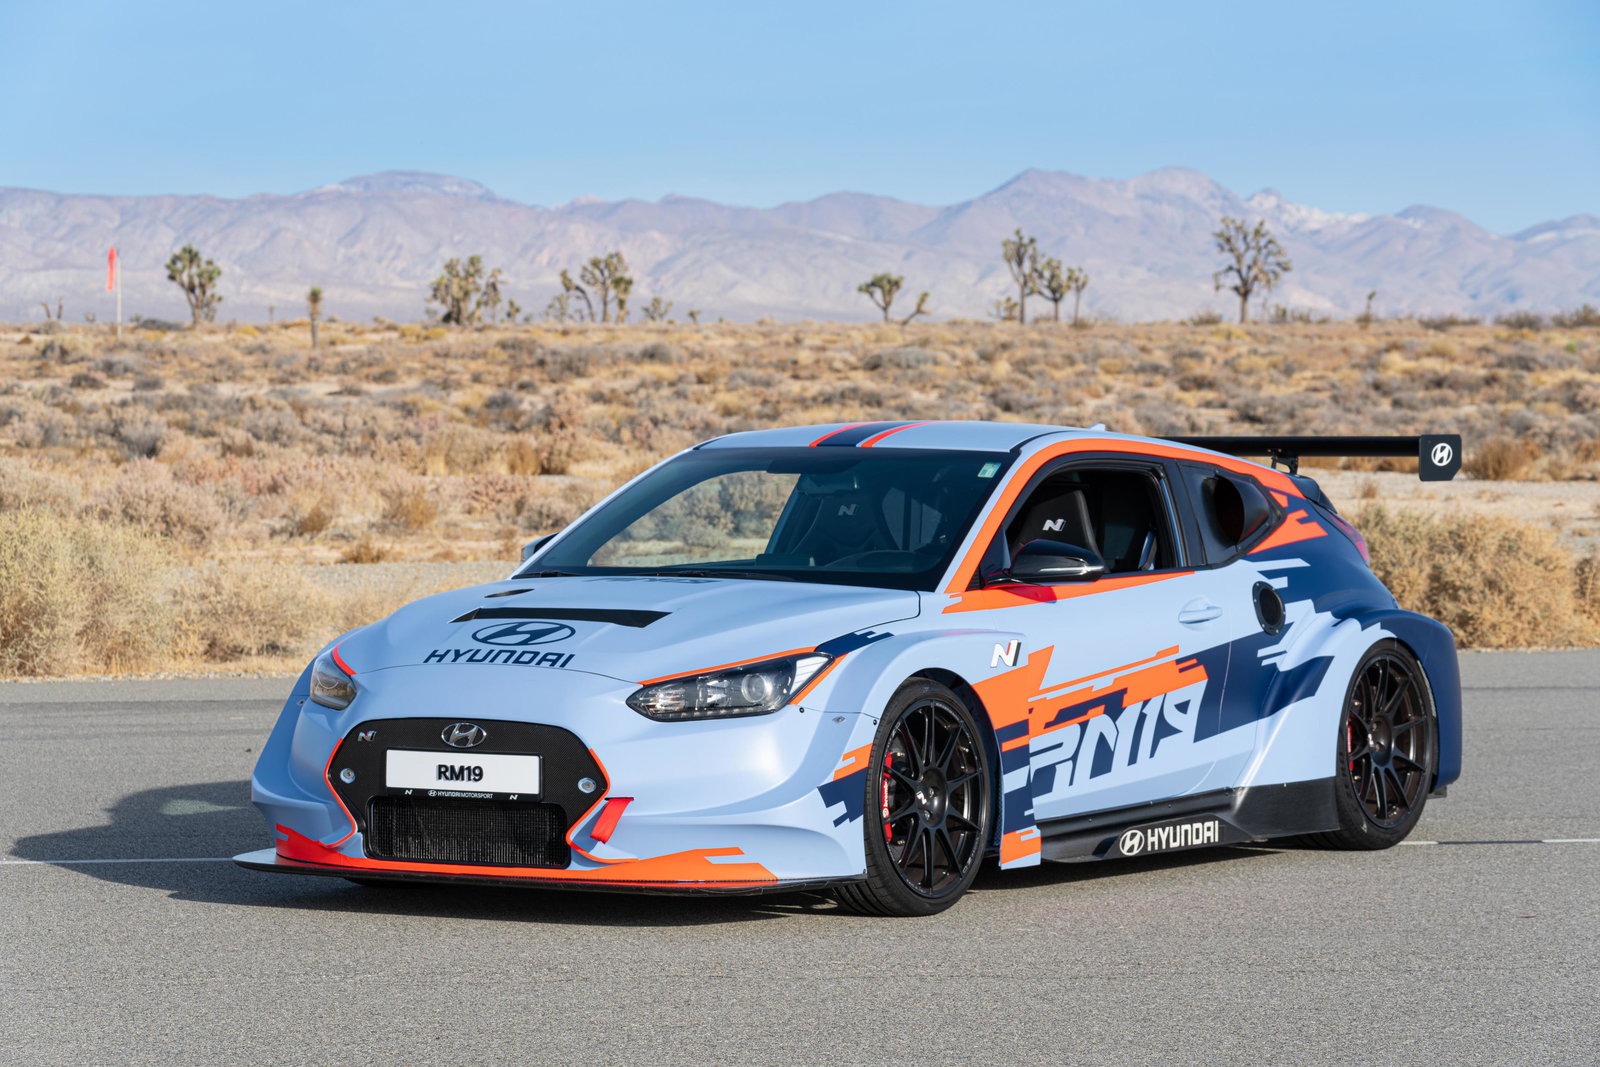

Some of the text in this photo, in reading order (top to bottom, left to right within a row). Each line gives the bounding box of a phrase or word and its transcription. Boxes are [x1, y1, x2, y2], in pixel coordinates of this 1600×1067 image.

[1042, 518, 1066, 532] N
[423, 649, 575, 668] HYUNDAI
[990, 639, 1022, 668] N
[436, 764, 484, 782] RM19
[1147, 820, 1219, 852] HYUNDAI
